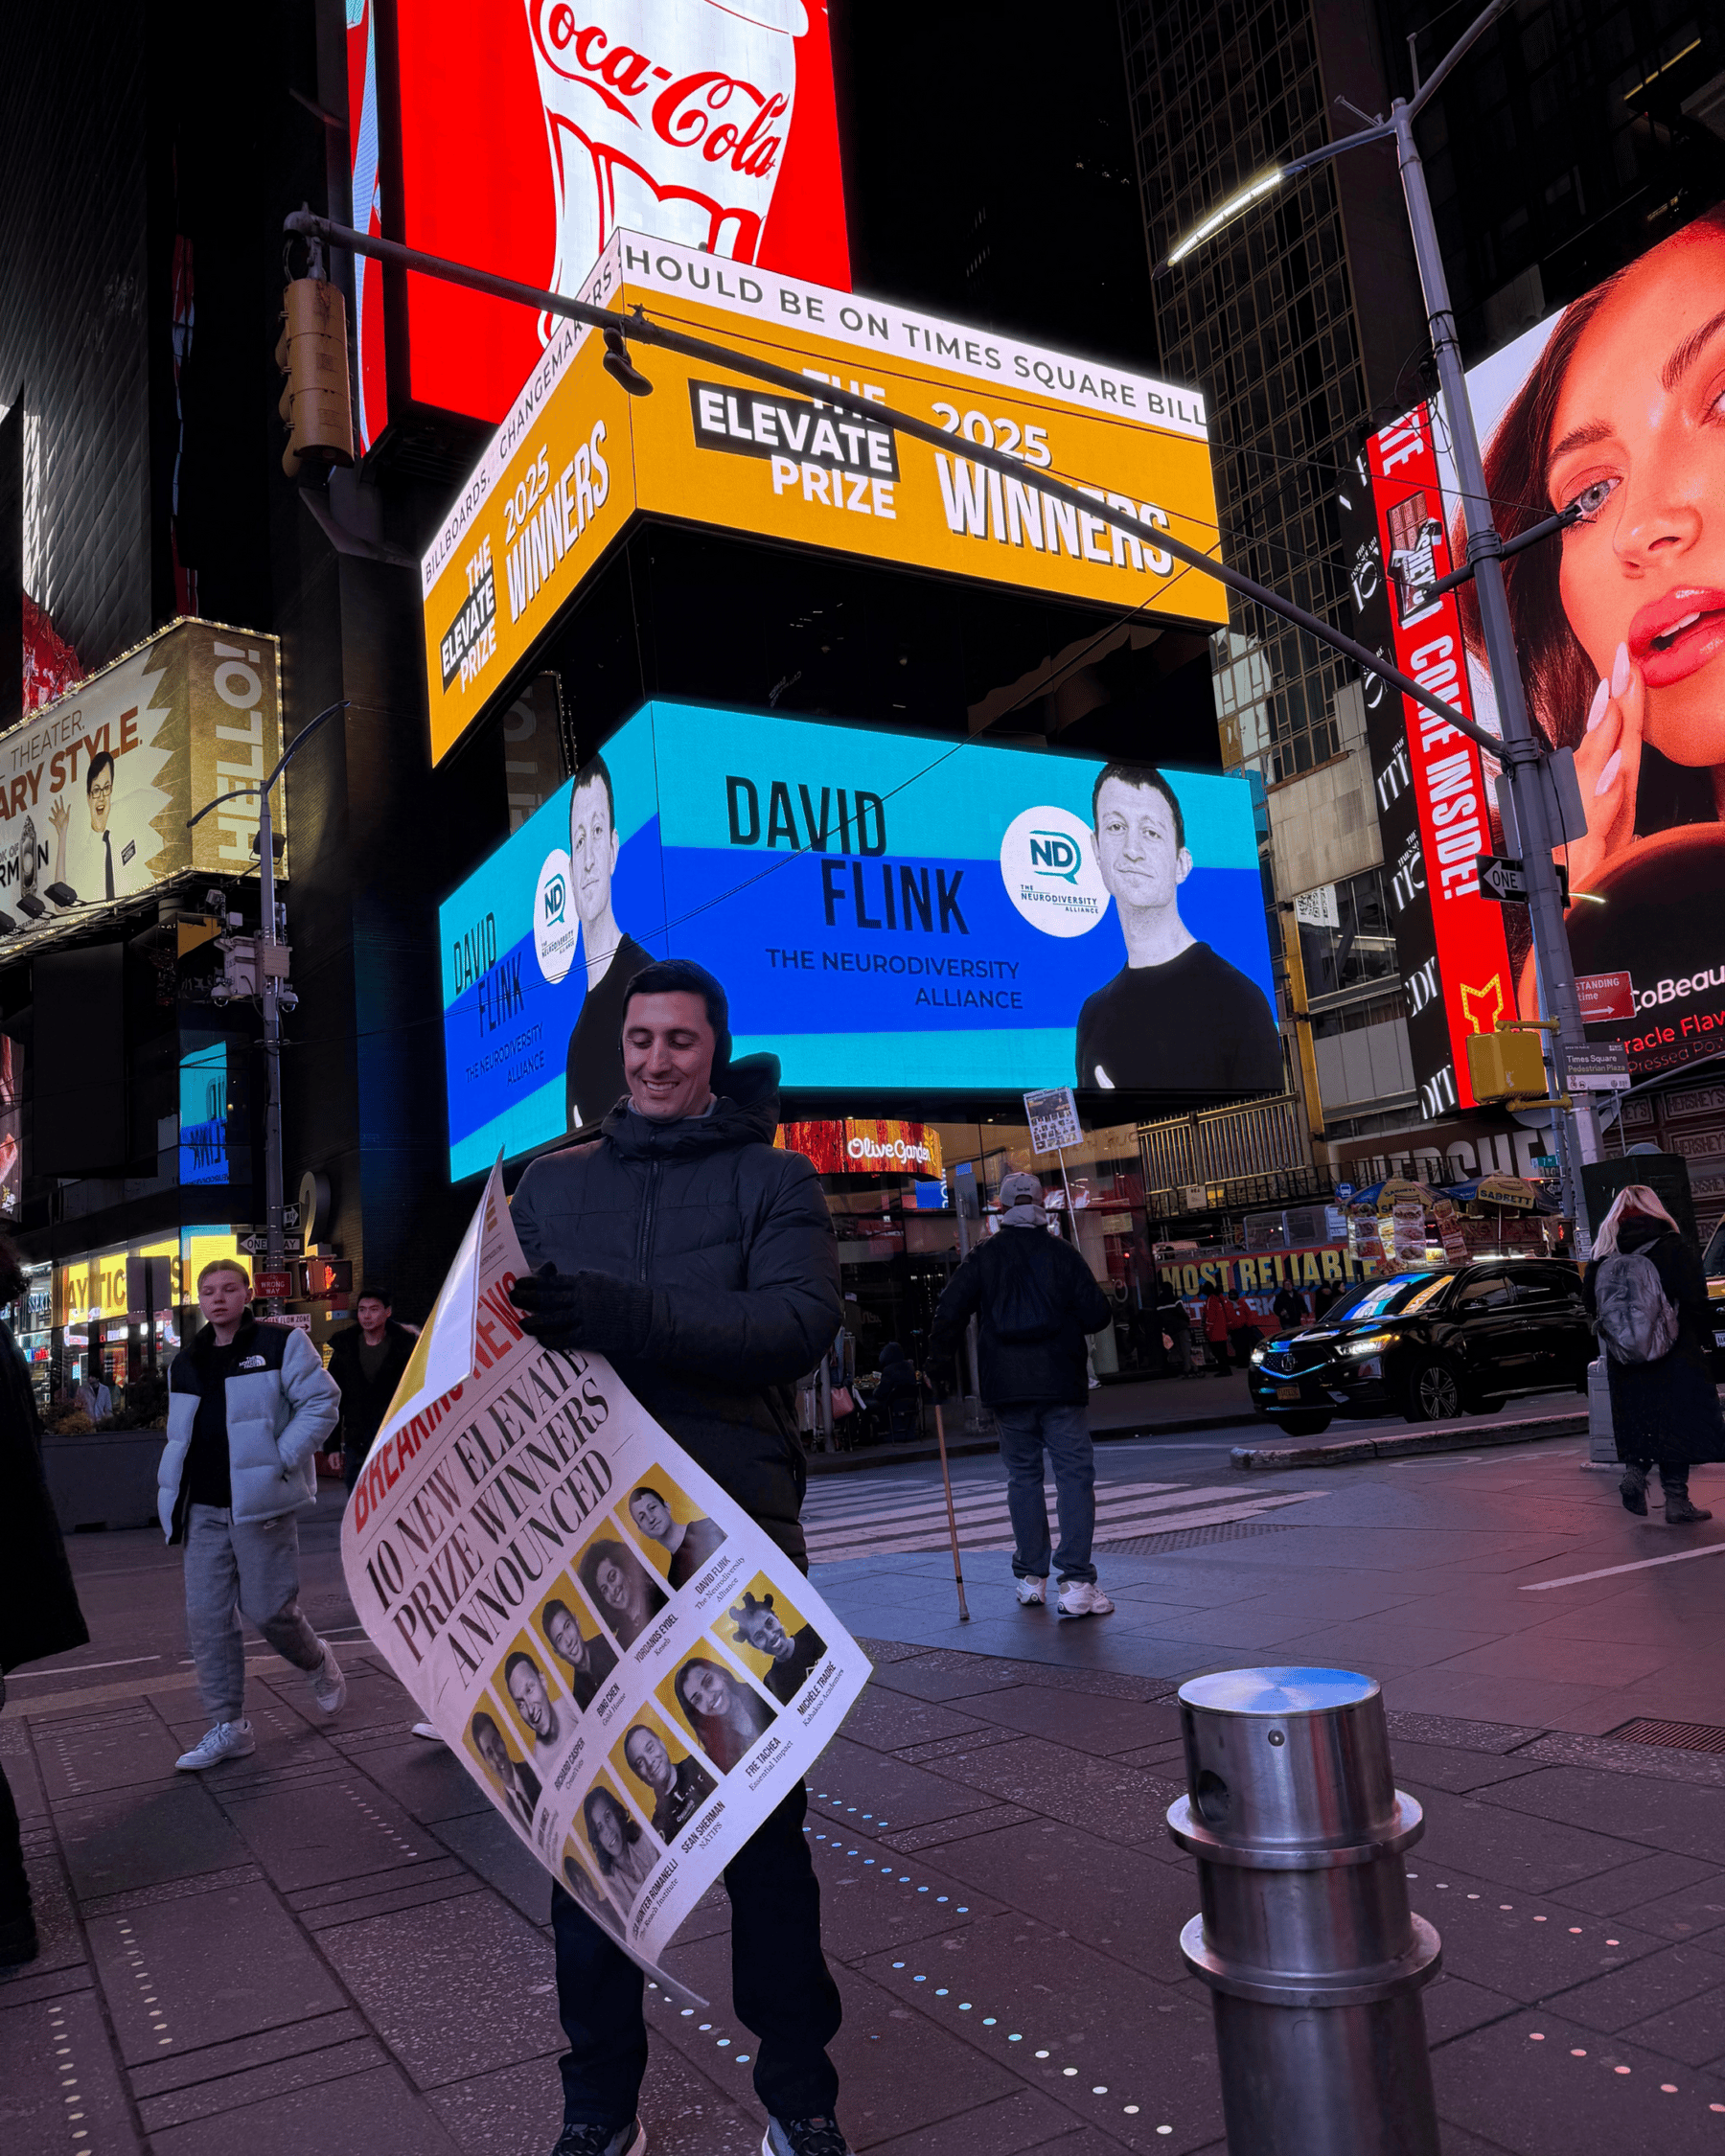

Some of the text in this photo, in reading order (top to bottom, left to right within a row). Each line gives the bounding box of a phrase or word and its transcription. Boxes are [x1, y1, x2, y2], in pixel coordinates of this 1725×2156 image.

[499, 260, 612, 460] CHANGEMAKRS
[617, 243, 765, 305] HOULD
[779, 288, 825, 323] BE
[840, 307, 890, 340] ON
[903, 322, 1002, 371] TIMES
[1014, 355, 1138, 408] SQUARE
[698, 389, 893, 473] ELEVATE
[932, 401, 1052, 469] 2025
[504, 443, 550, 546] 2025
[770, 454, 897, 520] PRIZE
[505, 419, 611, 626] WINNERS
[934, 452, 1174, 577] WINNERS
[466, 533, 493, 596] THE
[441, 573, 495, 677] ELEVATE
[460, 616, 496, 695] PRIZE
[1410, 634, 1466, 753] COME
[10, 709, 85, 772] THEATER.
[50, 705, 143, 794] STYLE.
[213, 640, 264, 862] HELLO!
[725, 774, 888, 858] DAVID
[1426, 749, 1483, 901] INSIDE!
[1029, 837, 1074, 868] ND
[1492, 869, 1519, 889] ONE
[544, 883, 564, 920] ND
[821, 859, 971, 935] FLINK
[1021, 892, 1098, 906] NEURODIVERSITY
[1065, 906, 1099, 914] ALLIANCE
[453, 911, 497, 997] DAVID
[765, 948, 1020, 980] THE NEURODIVERSITY
[477, 951, 526, 1039] FLINK
[914, 988, 1024, 1010] ALLIANCE
[1576, 977, 1621, 992] STANDING
[466, 1021, 544, 1084] THE NEURODIVERSITY
[507, 1050, 546, 1088] ALLIANCE
[1567, 1055, 1617, 1064] Times Square
[1568, 1065, 1606, 1073] Pedestrian
[847, 1137, 932, 1164] Olive Garden
[1480, 1188, 1533, 1206] SABRETT
[247, 1239, 296, 1250] ONE AY
[1161, 1259, 1230, 1297] MOST
[365, 1348, 589, 1615] 10 NEW ELEVATE
[391, 1378, 610, 1667] PRIZE WINNERS
[448, 1449, 613, 1692] ANNOUNCED
[695, 1555, 731, 1594] DAVID FLINK
[695, 1556, 746, 1611] The Neurodiversity
[716, 1576, 739, 1603] Alliance
[654, 1637, 671, 1657] Keseb
[596, 1683, 621, 1717] BING CHEN
[796, 1660, 838, 1716] MICHÈLE TRAORÉ
[821, 1668, 844, 1702] Academies
[745, 1736, 782, 1778] FRE TACHEA
[748, 1740, 794, 1792] Essential Impact
[680, 1830, 701, 1854] SEAN
[695, 1800, 726, 1837] SHERMAN
[648, 1858, 679, 1901] ROMANELLI
[656, 1877, 679, 1908] Institute
